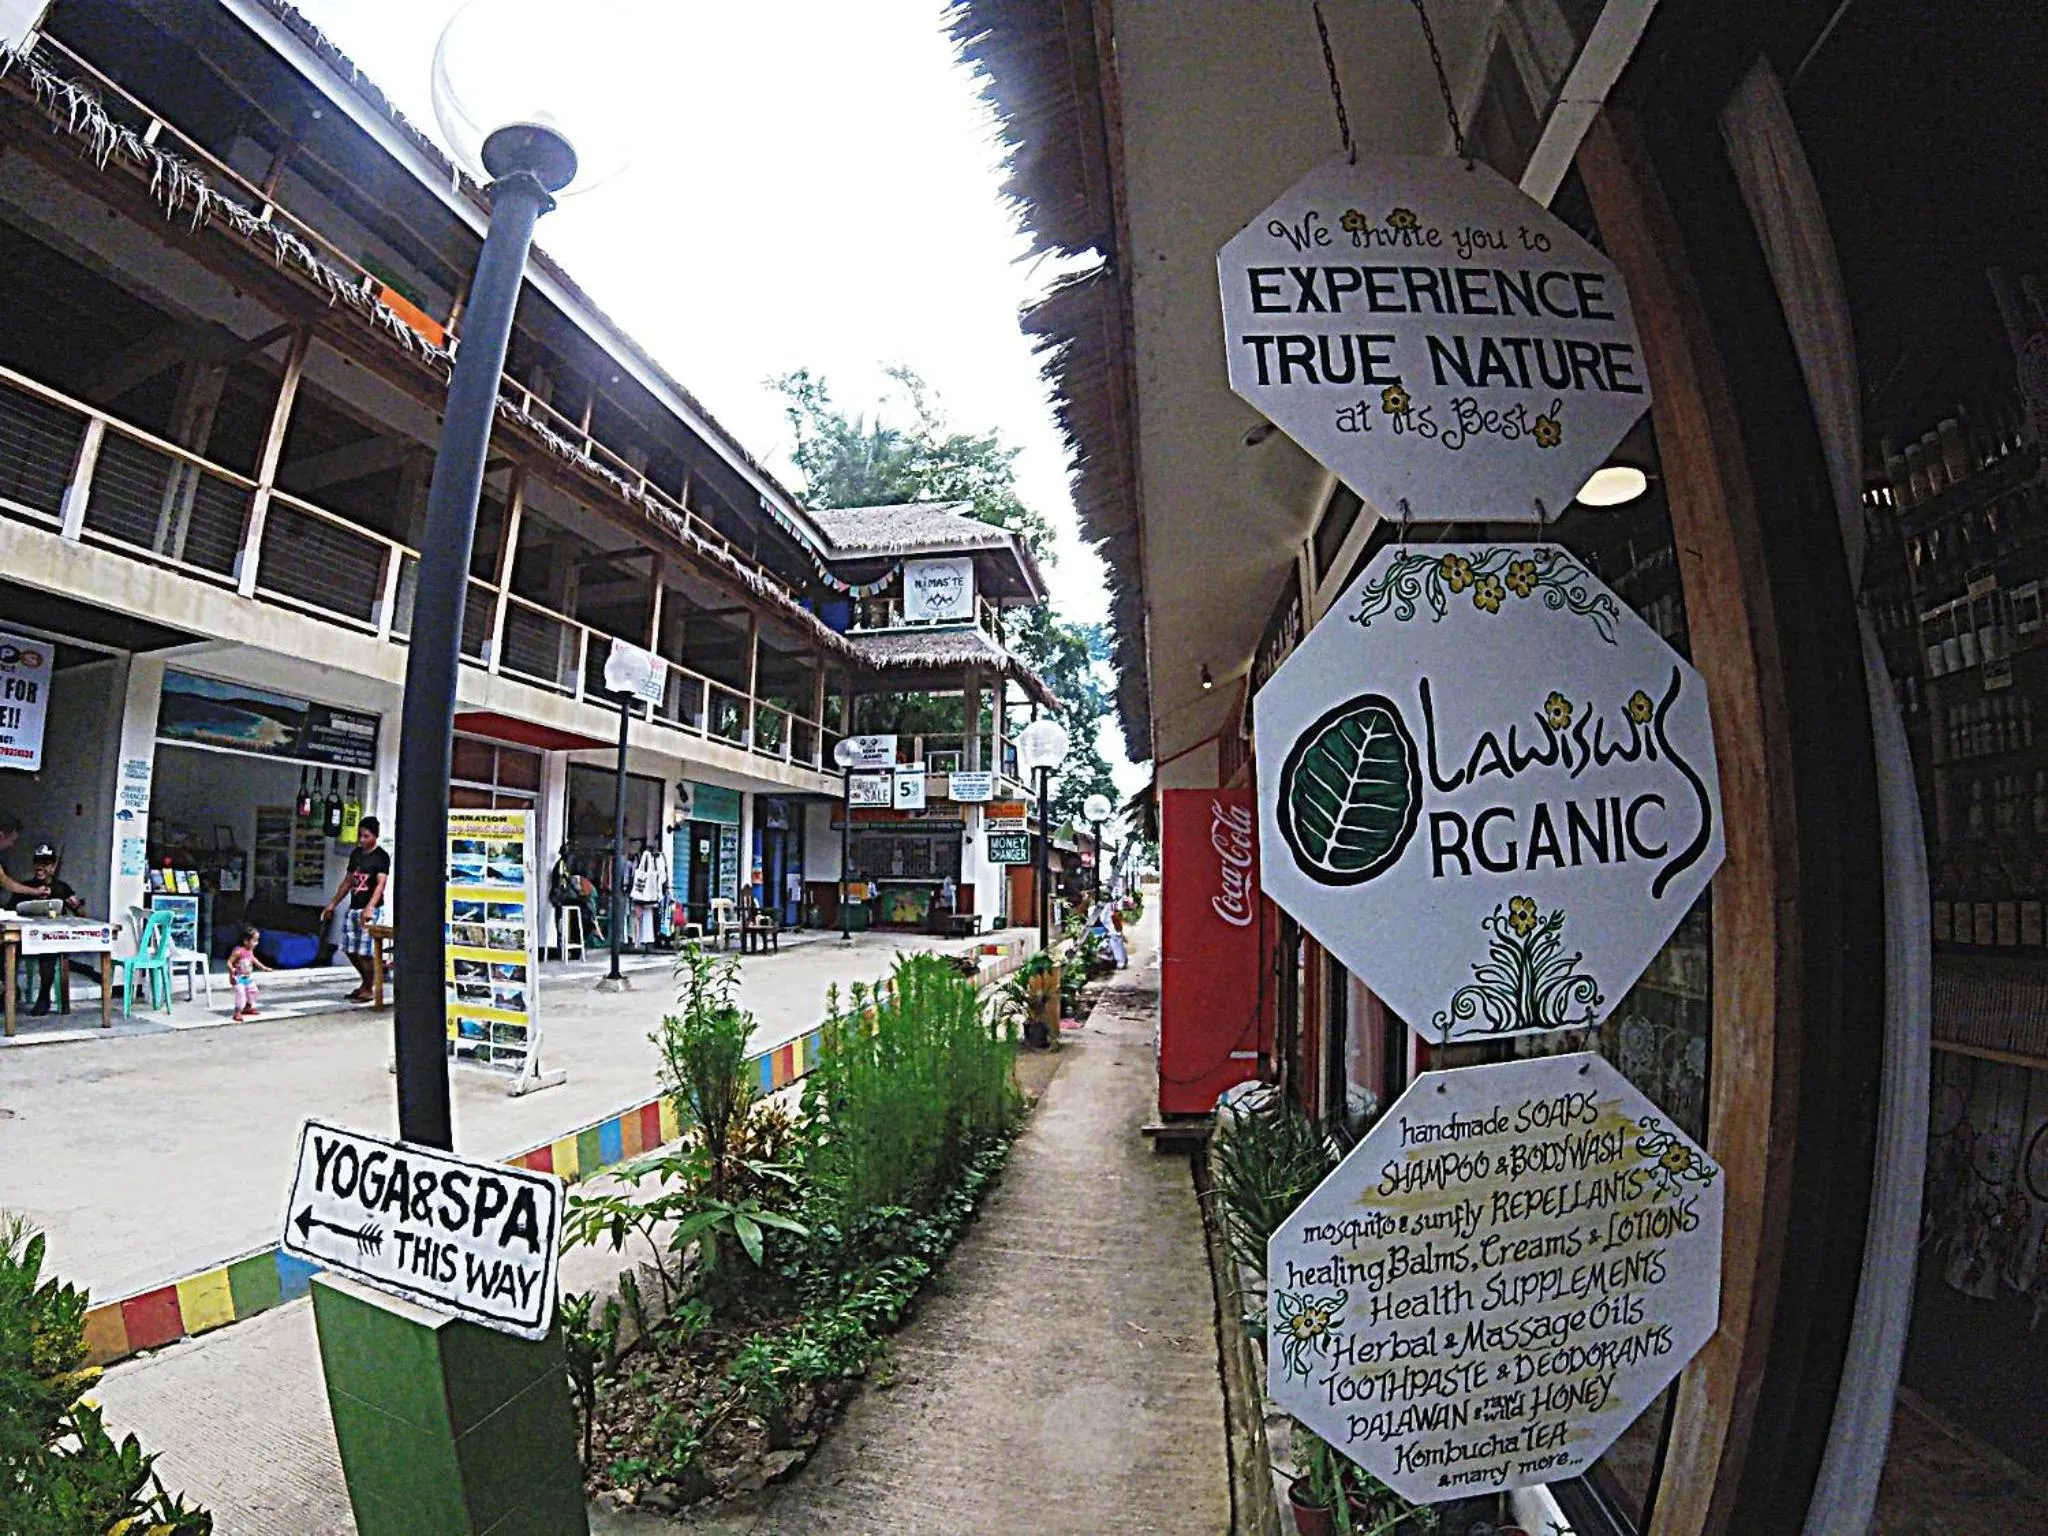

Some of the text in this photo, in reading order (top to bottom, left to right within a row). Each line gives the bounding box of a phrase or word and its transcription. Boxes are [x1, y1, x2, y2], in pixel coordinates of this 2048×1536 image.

[1268, 211, 1551, 260] We invite you to
[1247, 266, 1615, 321] EXPERIENCE
[1242, 334, 1644, 394] TRUE NATURE
[1336, 400, 1371, 432] at
[1385, 392, 1439, 438] its
[5, 678, 38, 703] FOR
[864, 789, 889, 801] SALE
[990, 836, 1026, 848] MONEY
[990, 848, 1026, 861] CHANGER
[1400, 1089, 1599, 1147] handmade SOAPS
[314, 1135, 541, 1255] YOGA&SPA
[1377, 1151, 1490, 1197] SHAMPOO
[1303, 1210, 1396, 1250] mosquito
[1491, 1167, 1643, 1226] REPELLANTS
[393, 1230, 541, 1311] THIS WAY
[1286, 1253, 1386, 1293] healing
[1479, 1226, 1583, 1268] Creams
[1602, 1194, 1700, 1252] LOTIONS
[1369, 1248, 1667, 1327] Health SUPPLEMENTS
[1330, 1326, 1438, 1371] Herbal
[1452, 1311, 1586, 1360] Massage
[1589, 1292, 1645, 1329] Oils
[1318, 1360, 1489, 1406] TOOTHPASTE
[1513, 1325, 1673, 1385] DEODORANTS
[1346, 1398, 1470, 1445] PALAWAN
[1484, 1372, 1616, 1422] wild HONEY
[1393, 1420, 1568, 1476] Kombucha TEA
